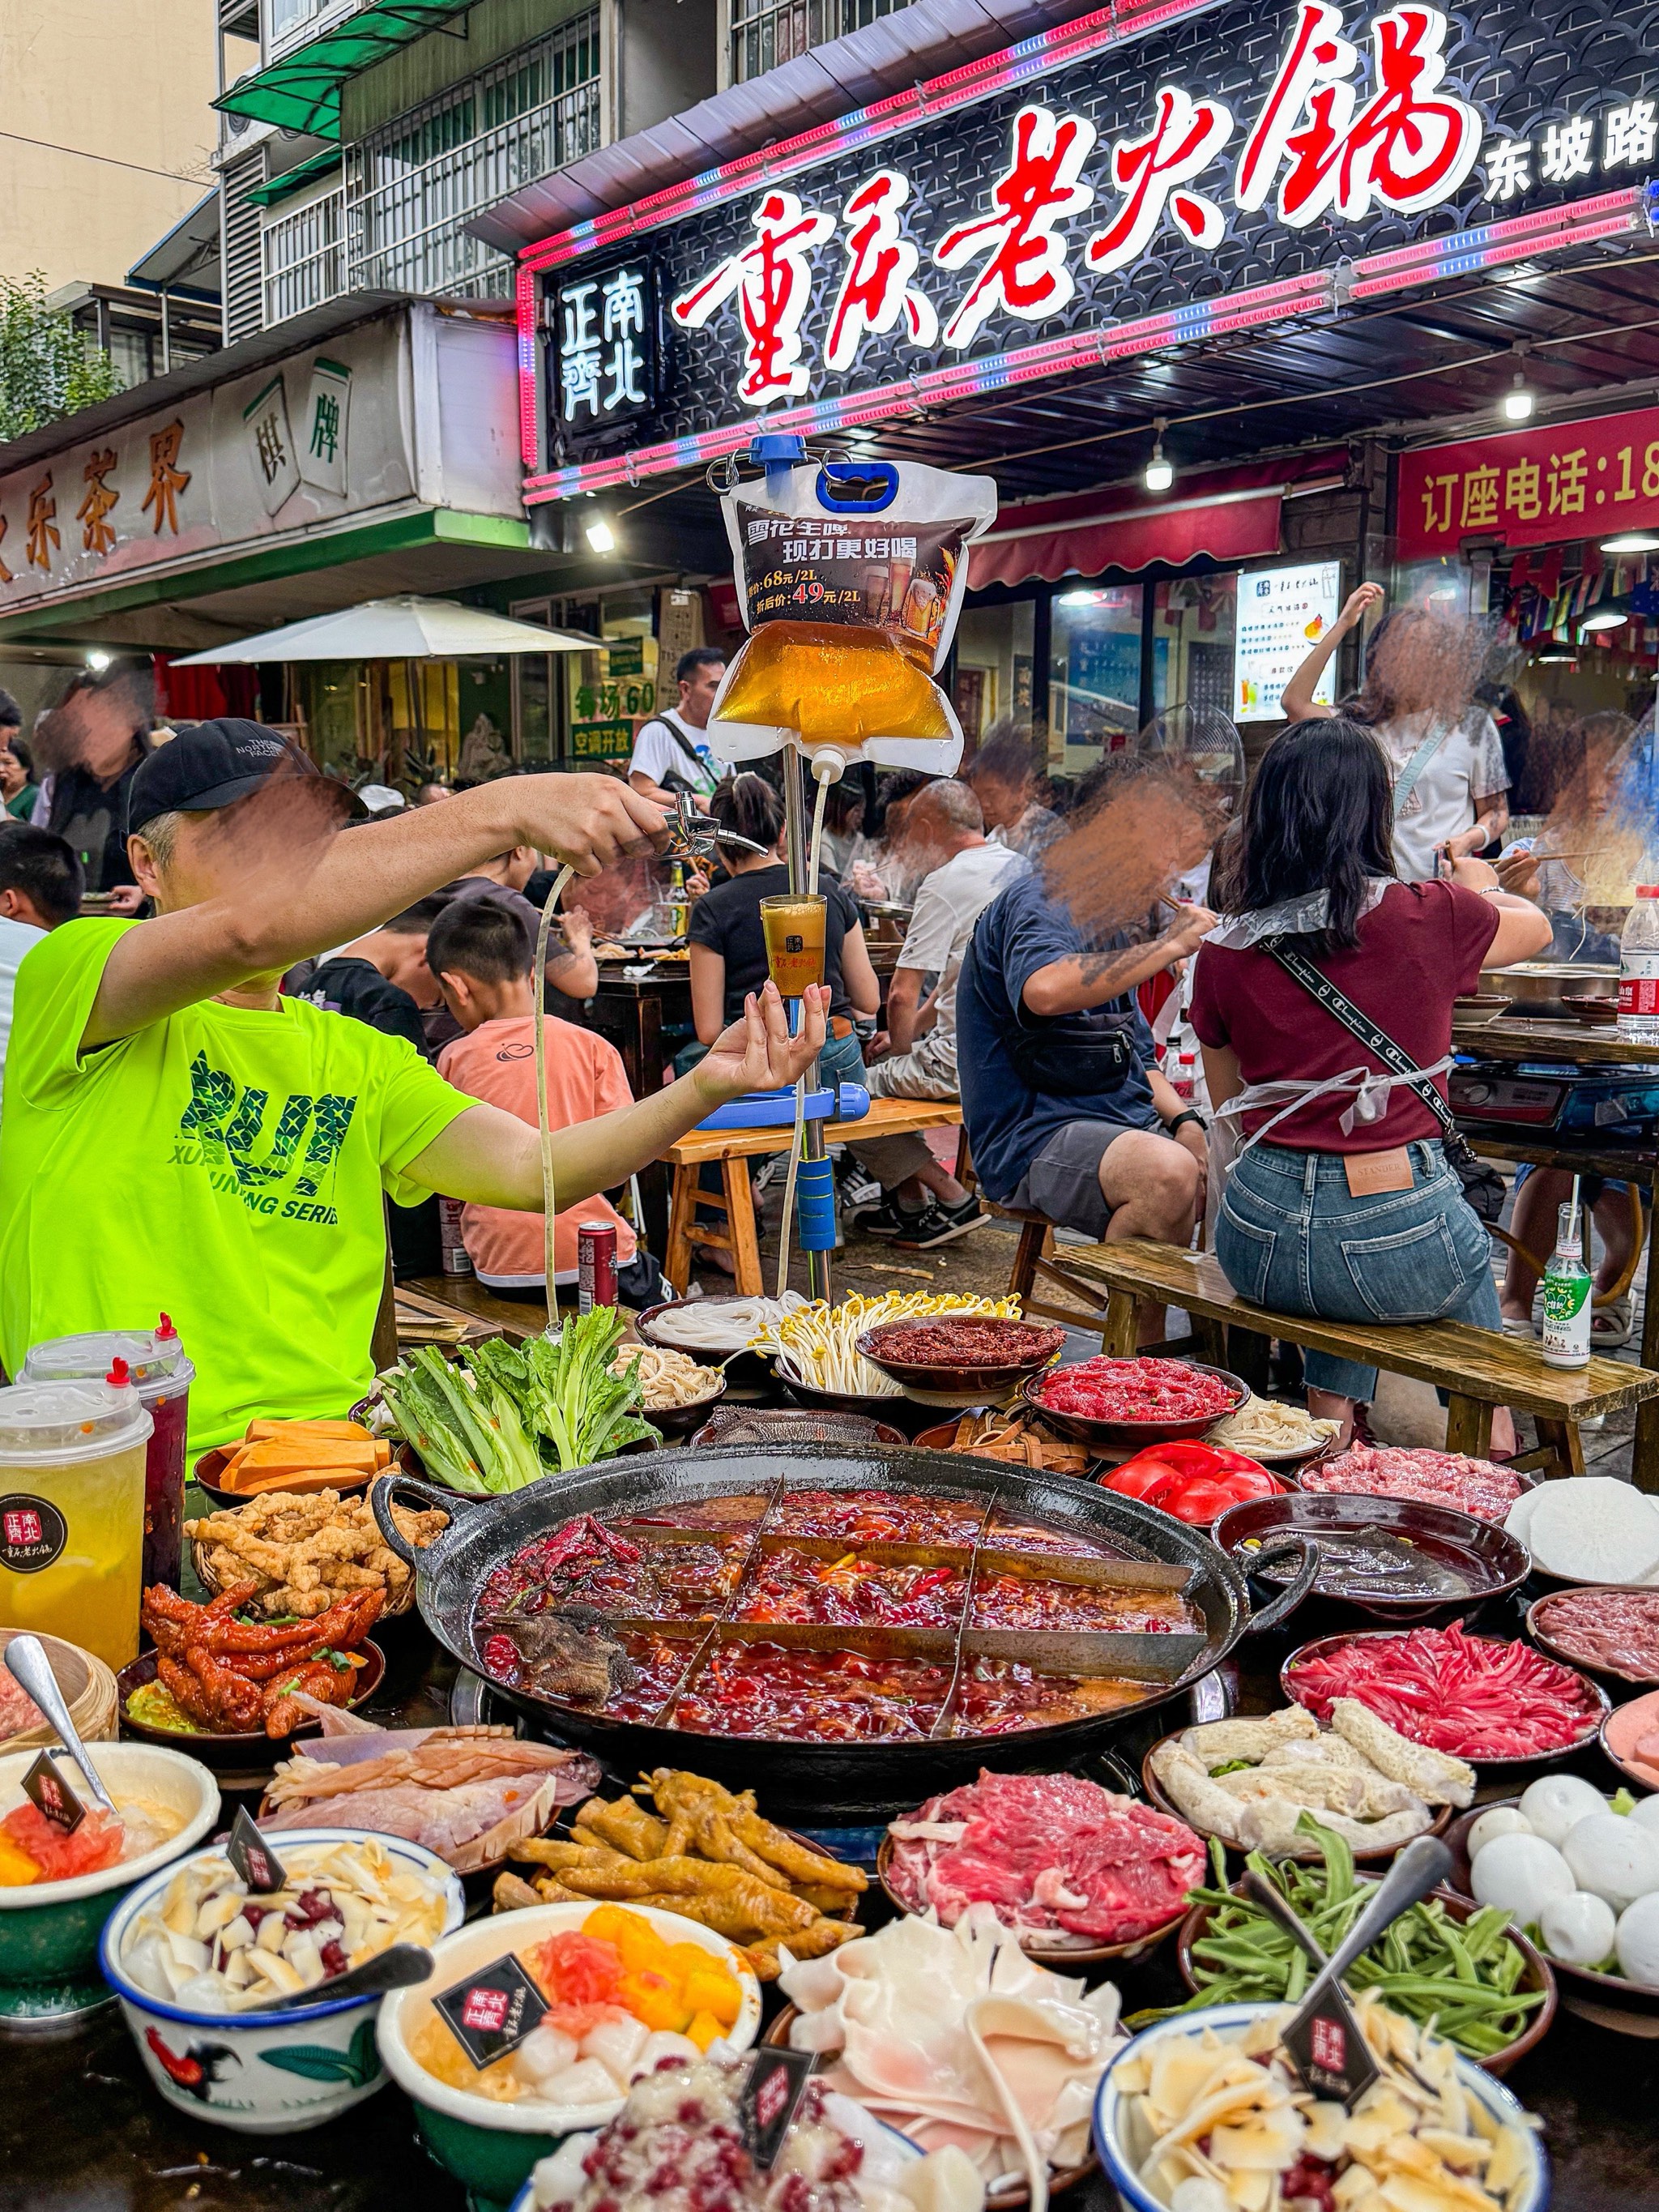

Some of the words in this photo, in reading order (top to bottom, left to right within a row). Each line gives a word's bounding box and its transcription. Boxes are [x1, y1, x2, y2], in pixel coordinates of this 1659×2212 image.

[1484, 100, 1658, 203] 东坡路
[671, 2, 1483, 404] 重庆老火锅
[0, 418, 192, 583] 乐茶界
[783, 537, 917, 564] 现打更好喝
[574, 727, 629, 755] 空调开放
[1333, 997, 1367, 1034] Champion
